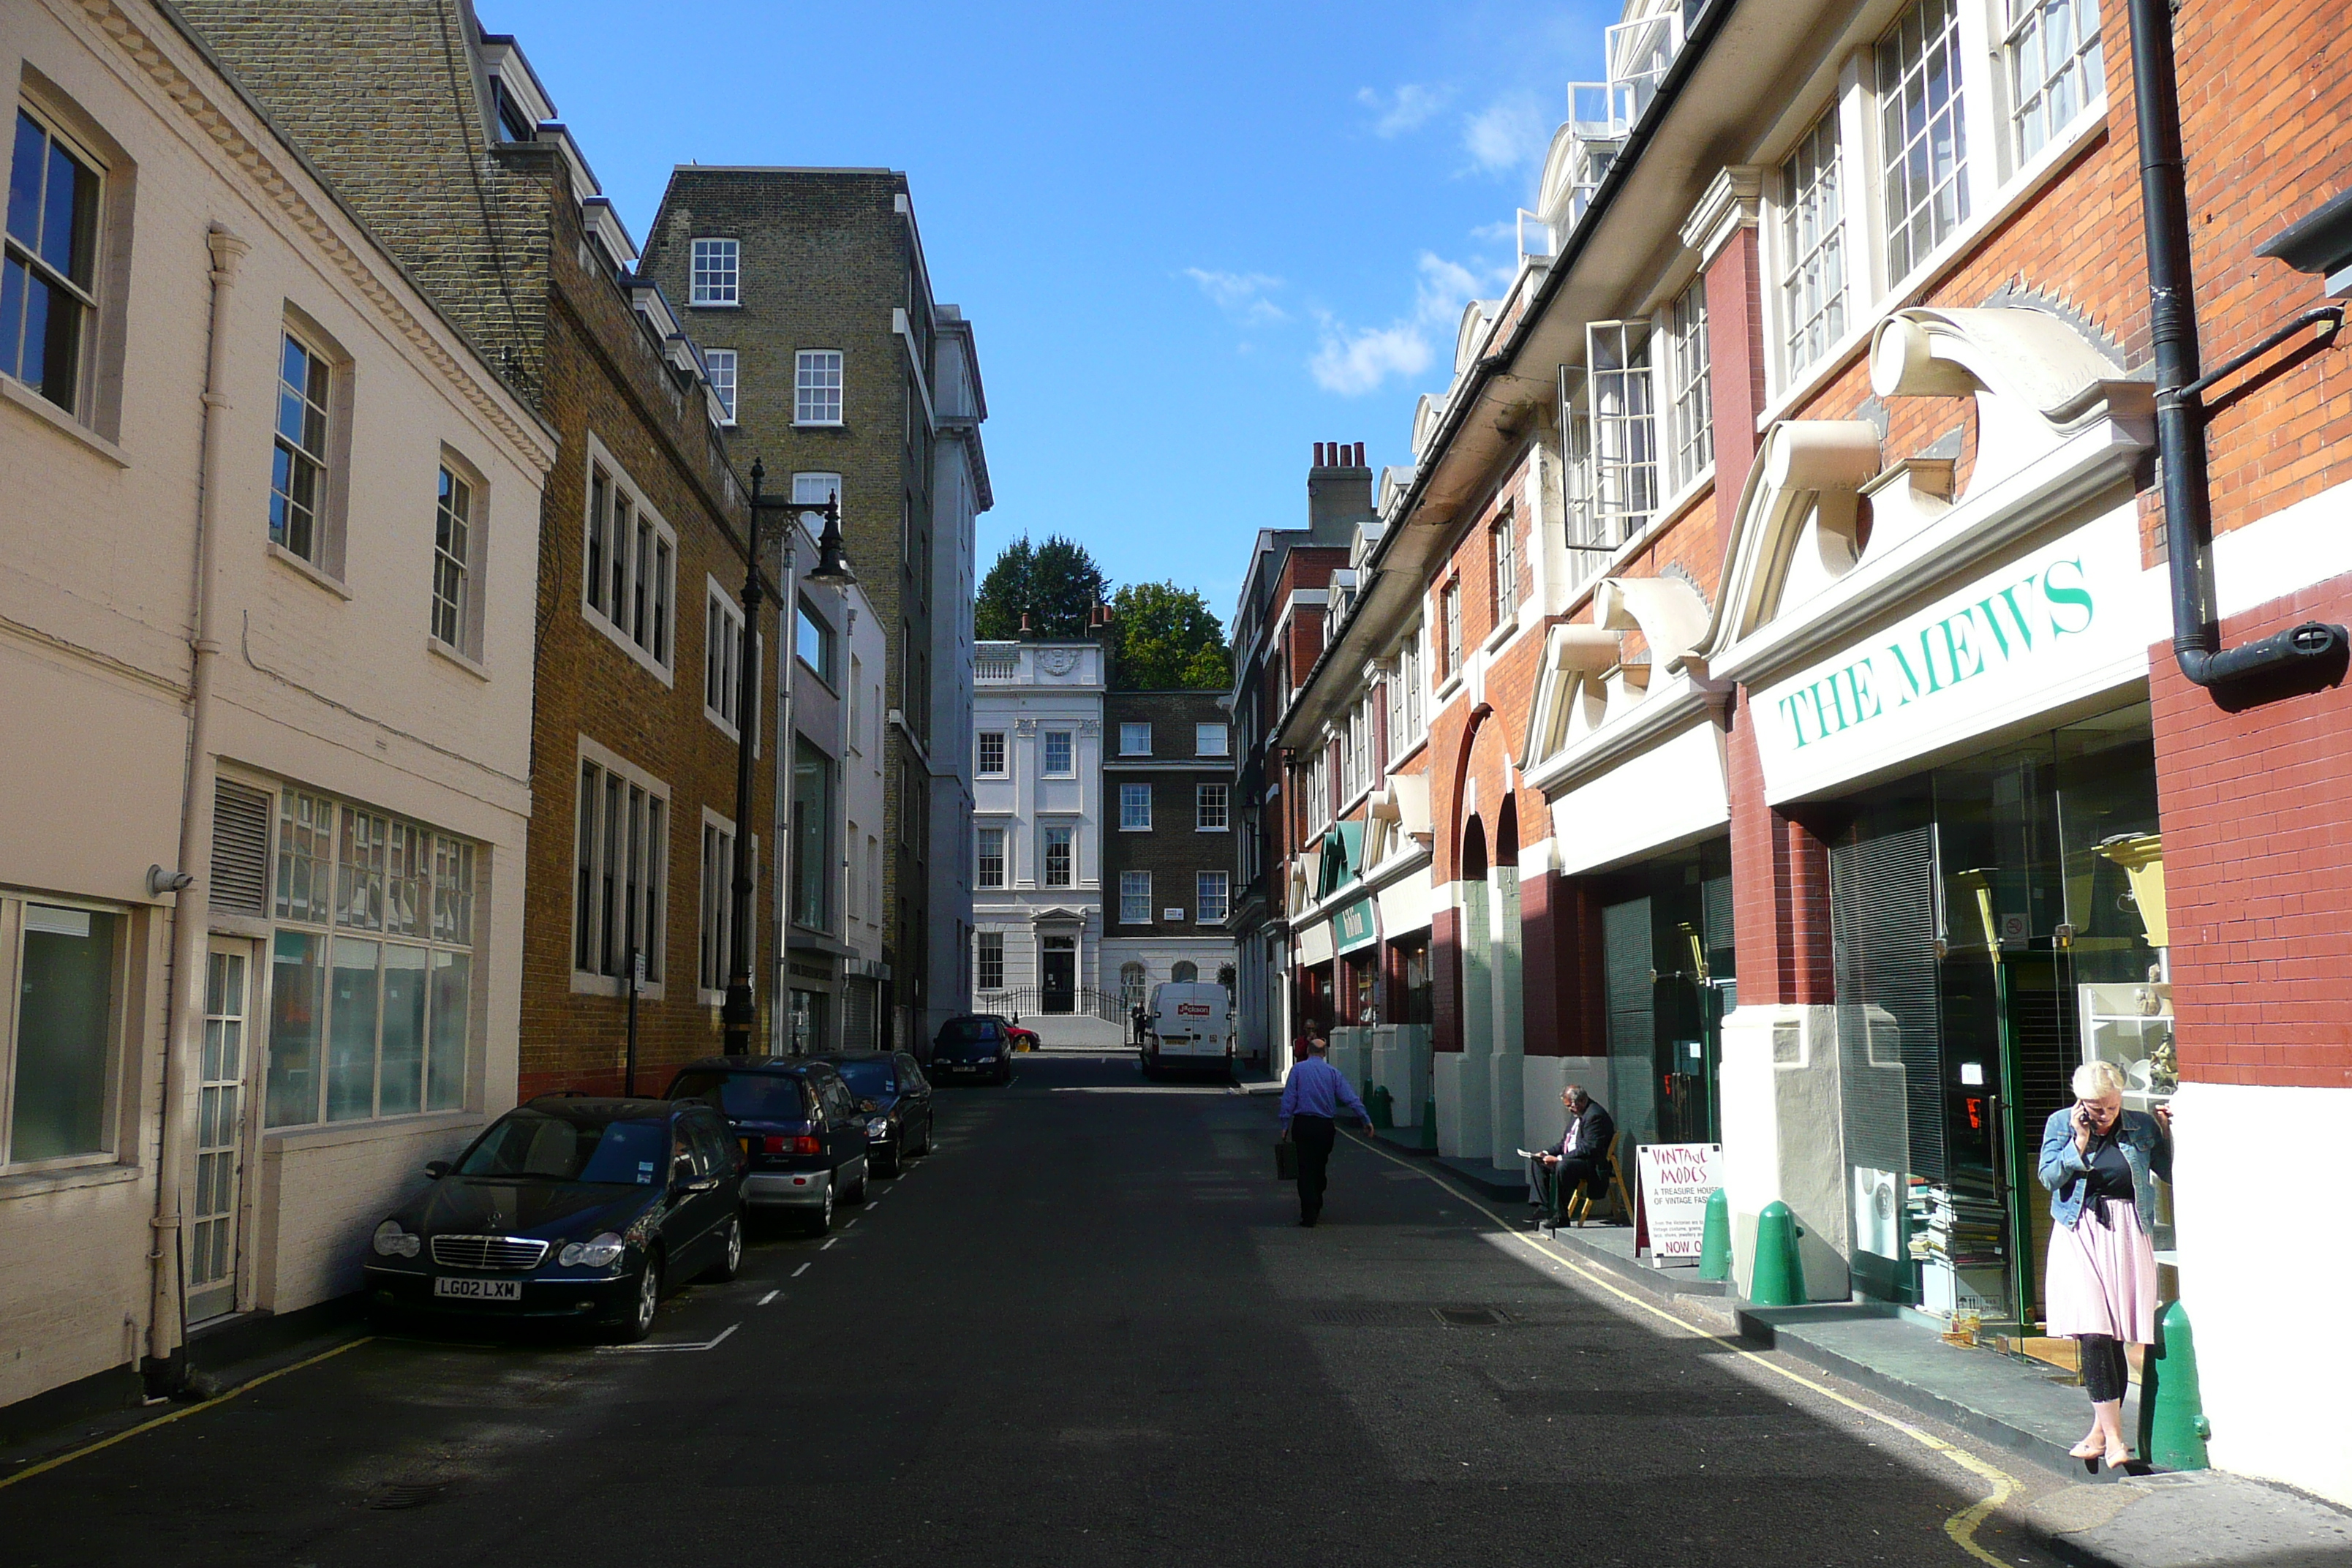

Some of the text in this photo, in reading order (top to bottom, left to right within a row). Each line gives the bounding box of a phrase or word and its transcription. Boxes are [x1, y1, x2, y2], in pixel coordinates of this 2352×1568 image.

[1779, 554, 2093, 750] THE MEWS
[1652, 1147, 1708, 1165] VINTAGE
[1662, 1166, 1707, 1184] MODES
[1654, 1188, 1659, 1196] A
[1660, 1187, 1695, 1195] TREASURE
[1665, 1196, 1692, 1205] VINTAGE
[1665, 1240, 1689, 1253] NOW
[440, 1280, 515, 1297] LG02 LXM
